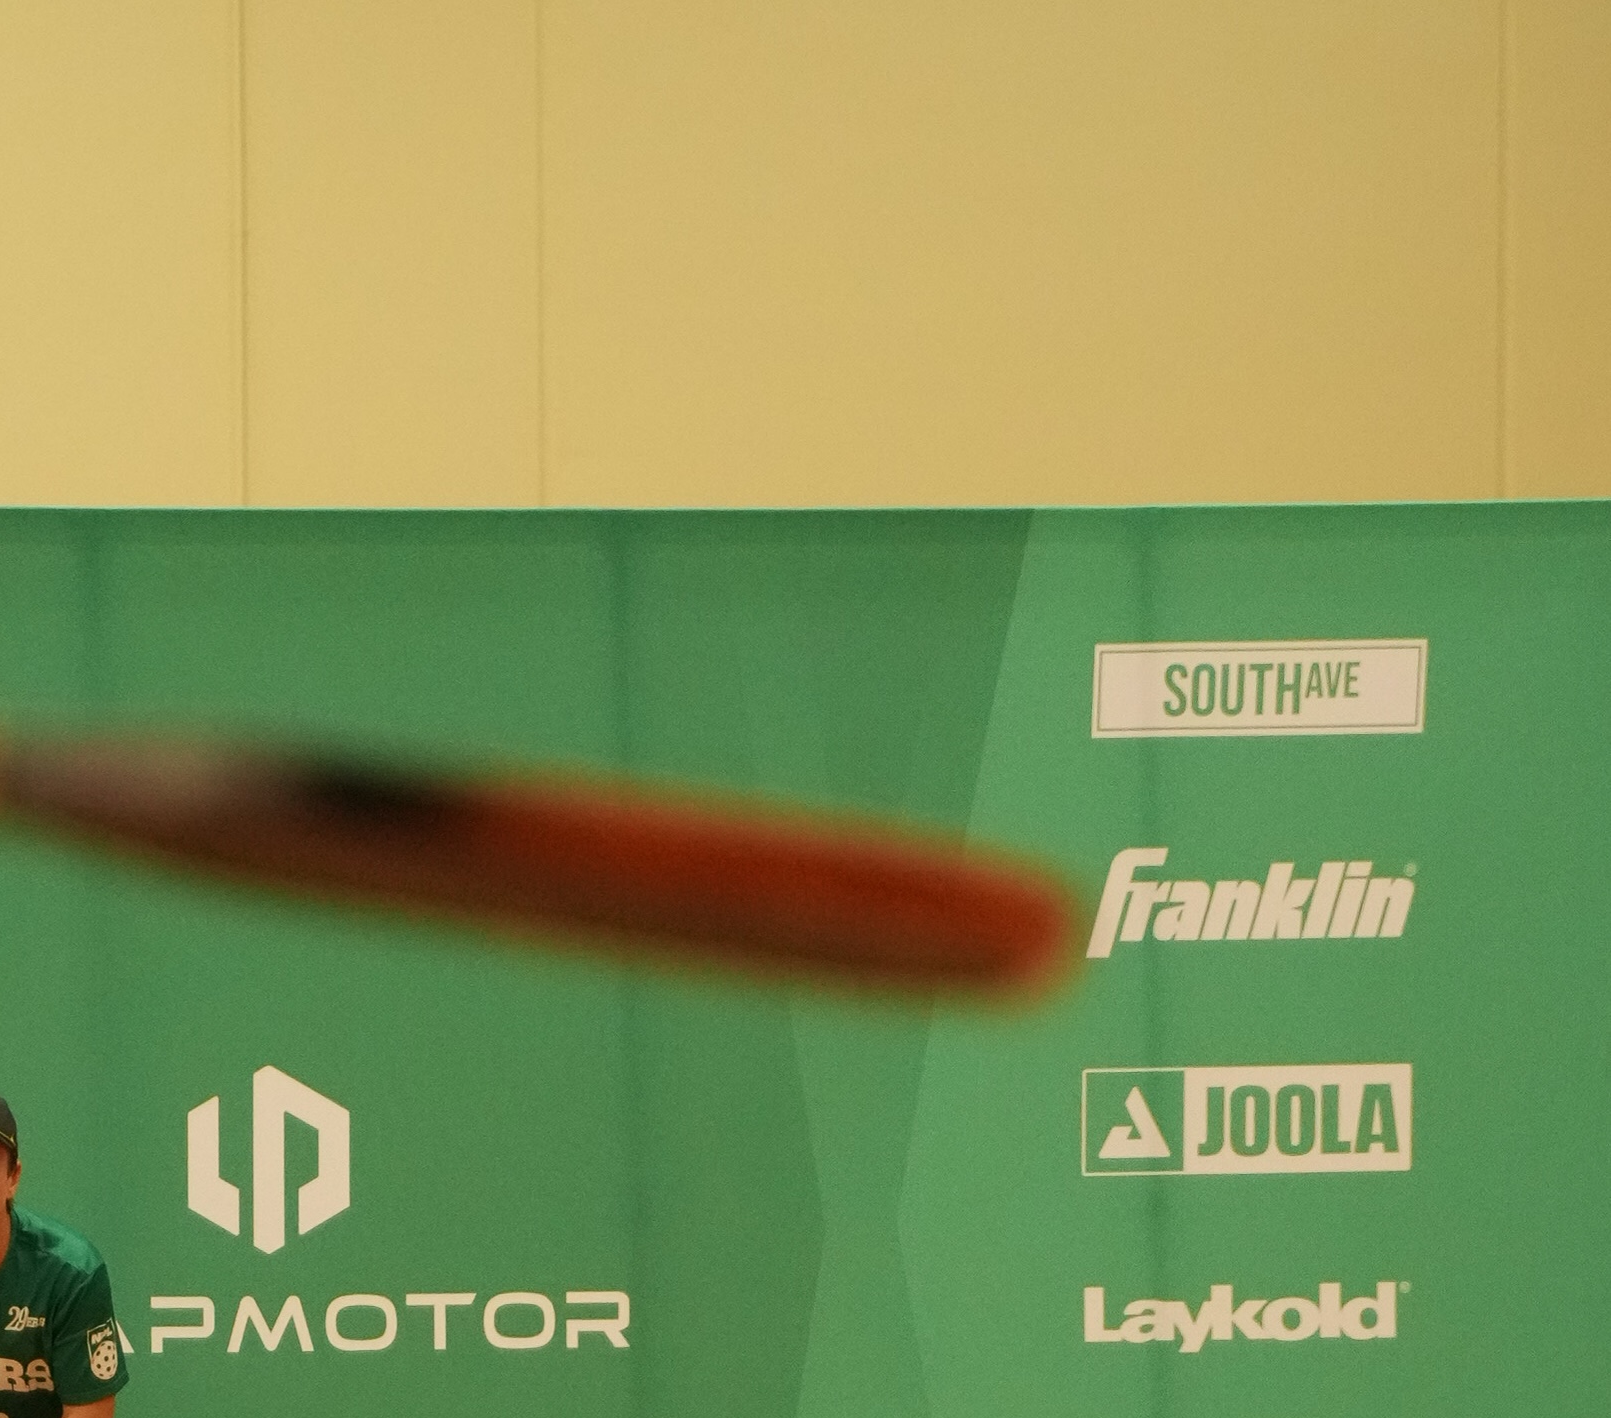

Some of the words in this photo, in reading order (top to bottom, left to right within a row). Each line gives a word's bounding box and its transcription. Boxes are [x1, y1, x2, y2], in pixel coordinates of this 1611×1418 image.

[1086, 847, 1416, 959] franklin
[1197, 1084, 1400, 1157] JOOLA
[1084, 1281, 1397, 1353] Laykold
